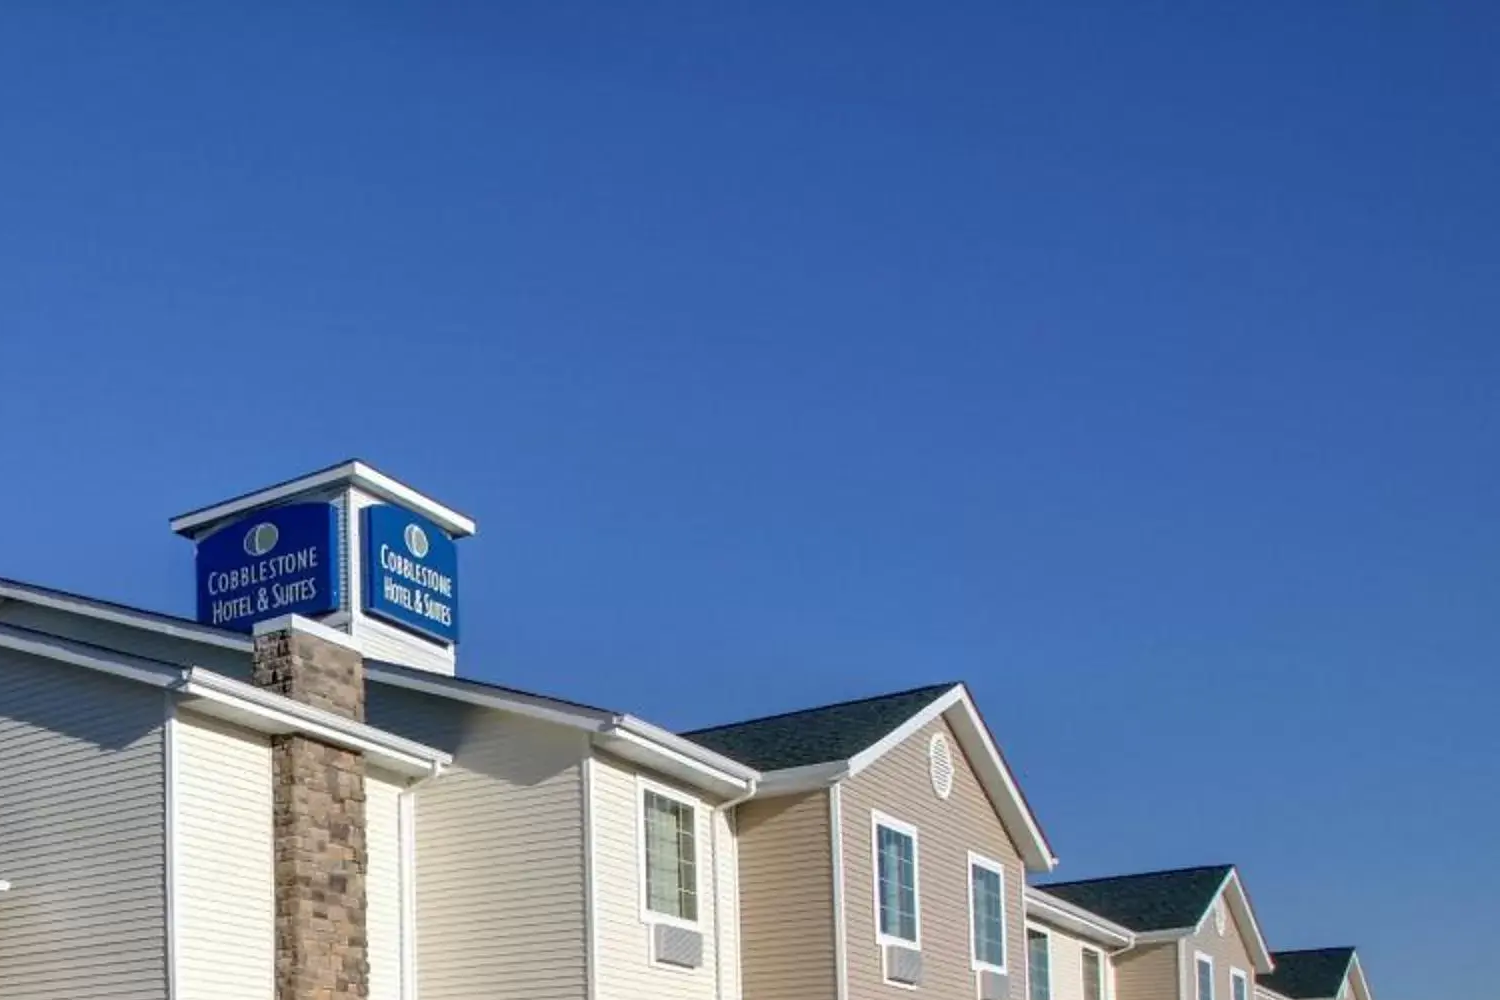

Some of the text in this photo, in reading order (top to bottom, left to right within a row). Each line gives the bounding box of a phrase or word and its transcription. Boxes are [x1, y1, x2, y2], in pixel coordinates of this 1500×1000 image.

[208, 546, 318, 595] COBBLESTONE
[381, 544, 452, 598] COBBLESTONE
[212, 577, 316, 625] HOTEL & SUITES
[384, 575, 452, 627] HOTEL & SUITES
